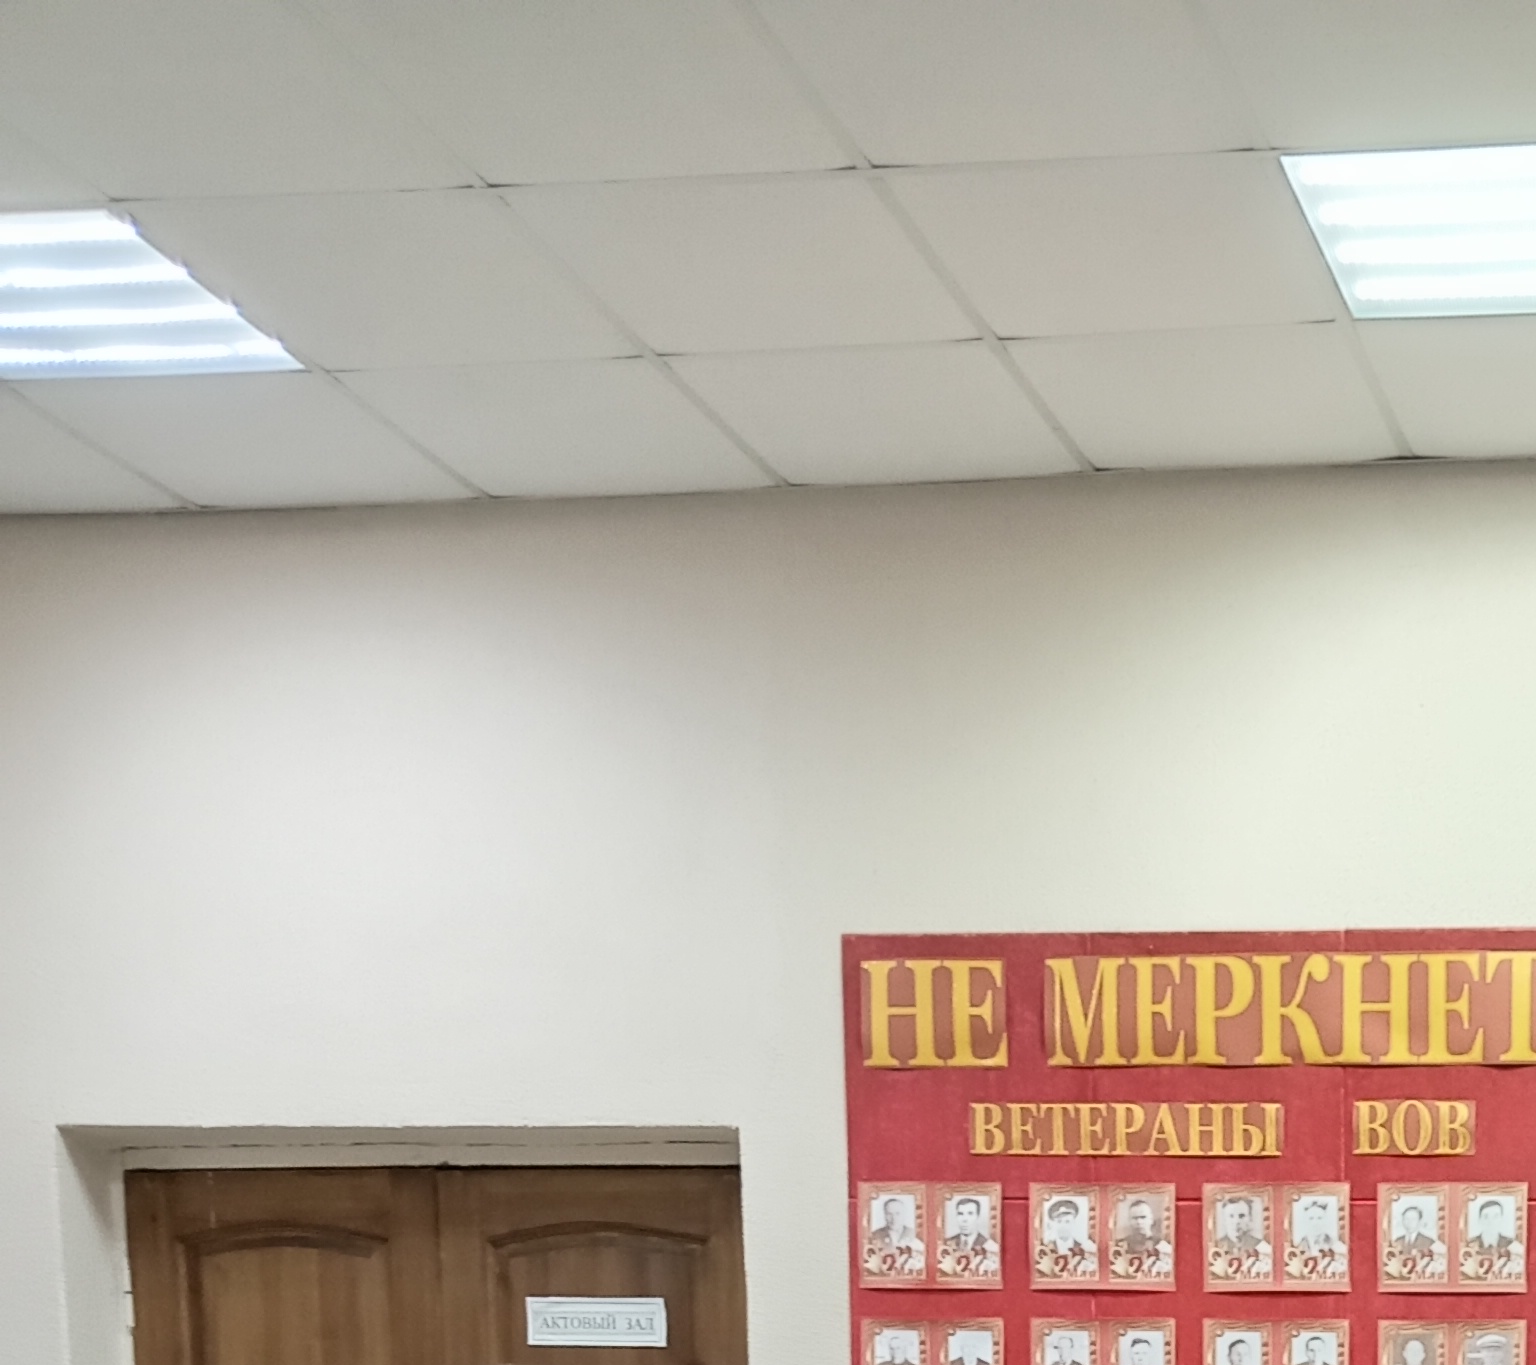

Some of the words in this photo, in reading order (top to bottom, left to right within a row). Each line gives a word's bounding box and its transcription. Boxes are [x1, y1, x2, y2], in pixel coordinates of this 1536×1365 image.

[863, 960, 1005, 1066] НЕ
[970, 1103, 1281, 1156] ВЕТЕРАНЫ
[1353, 1100, 1472, 1154] ВОВ
[540, 1313, 617, 1331] АКТОВЫЙ
[625, 1317, 655, 1332] ЗАЛ
